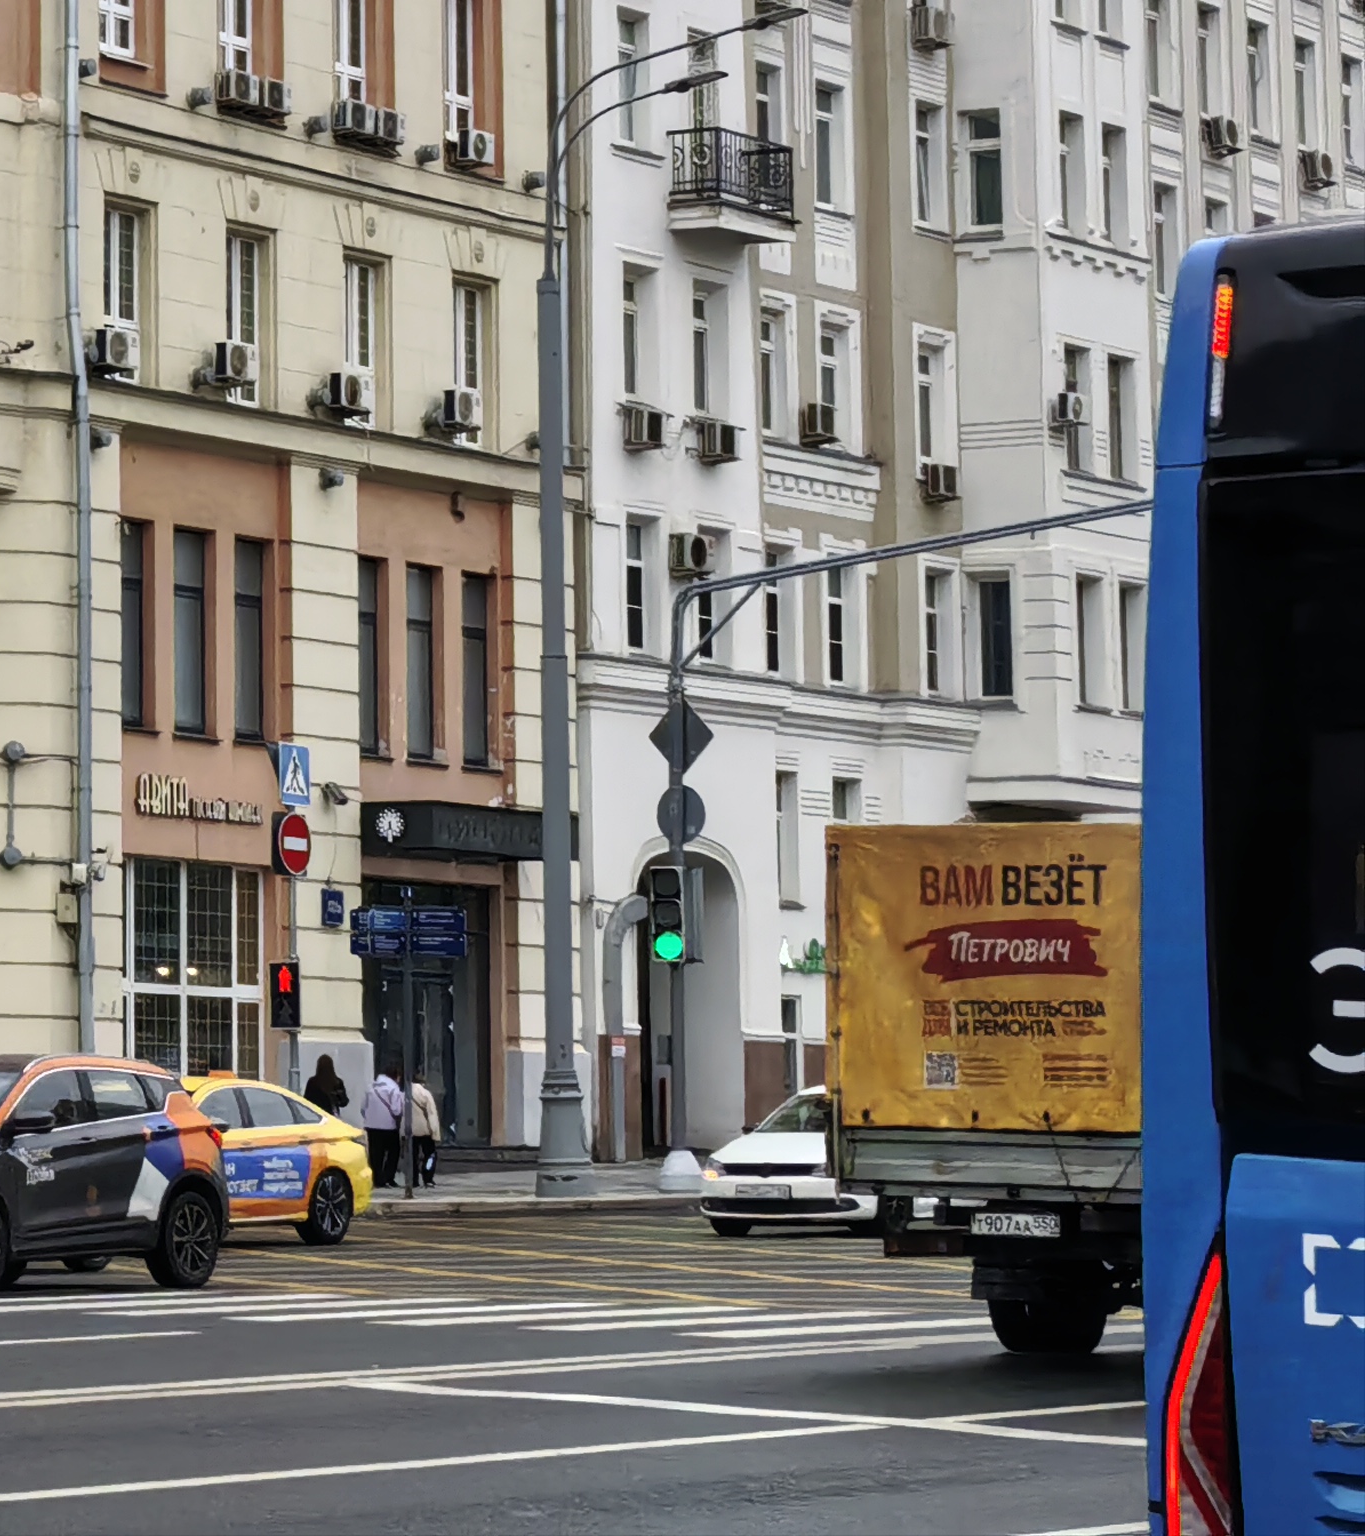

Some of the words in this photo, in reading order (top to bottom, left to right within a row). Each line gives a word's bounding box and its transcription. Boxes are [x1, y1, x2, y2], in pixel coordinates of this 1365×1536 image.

[137, 772, 189, 816] АВИТА
[920, 865, 994, 906] ВАМ
[1002, 853, 1107, 906] ВЕЗЁТ
[972, 1019, 1056, 1037] РЕМОНТА
